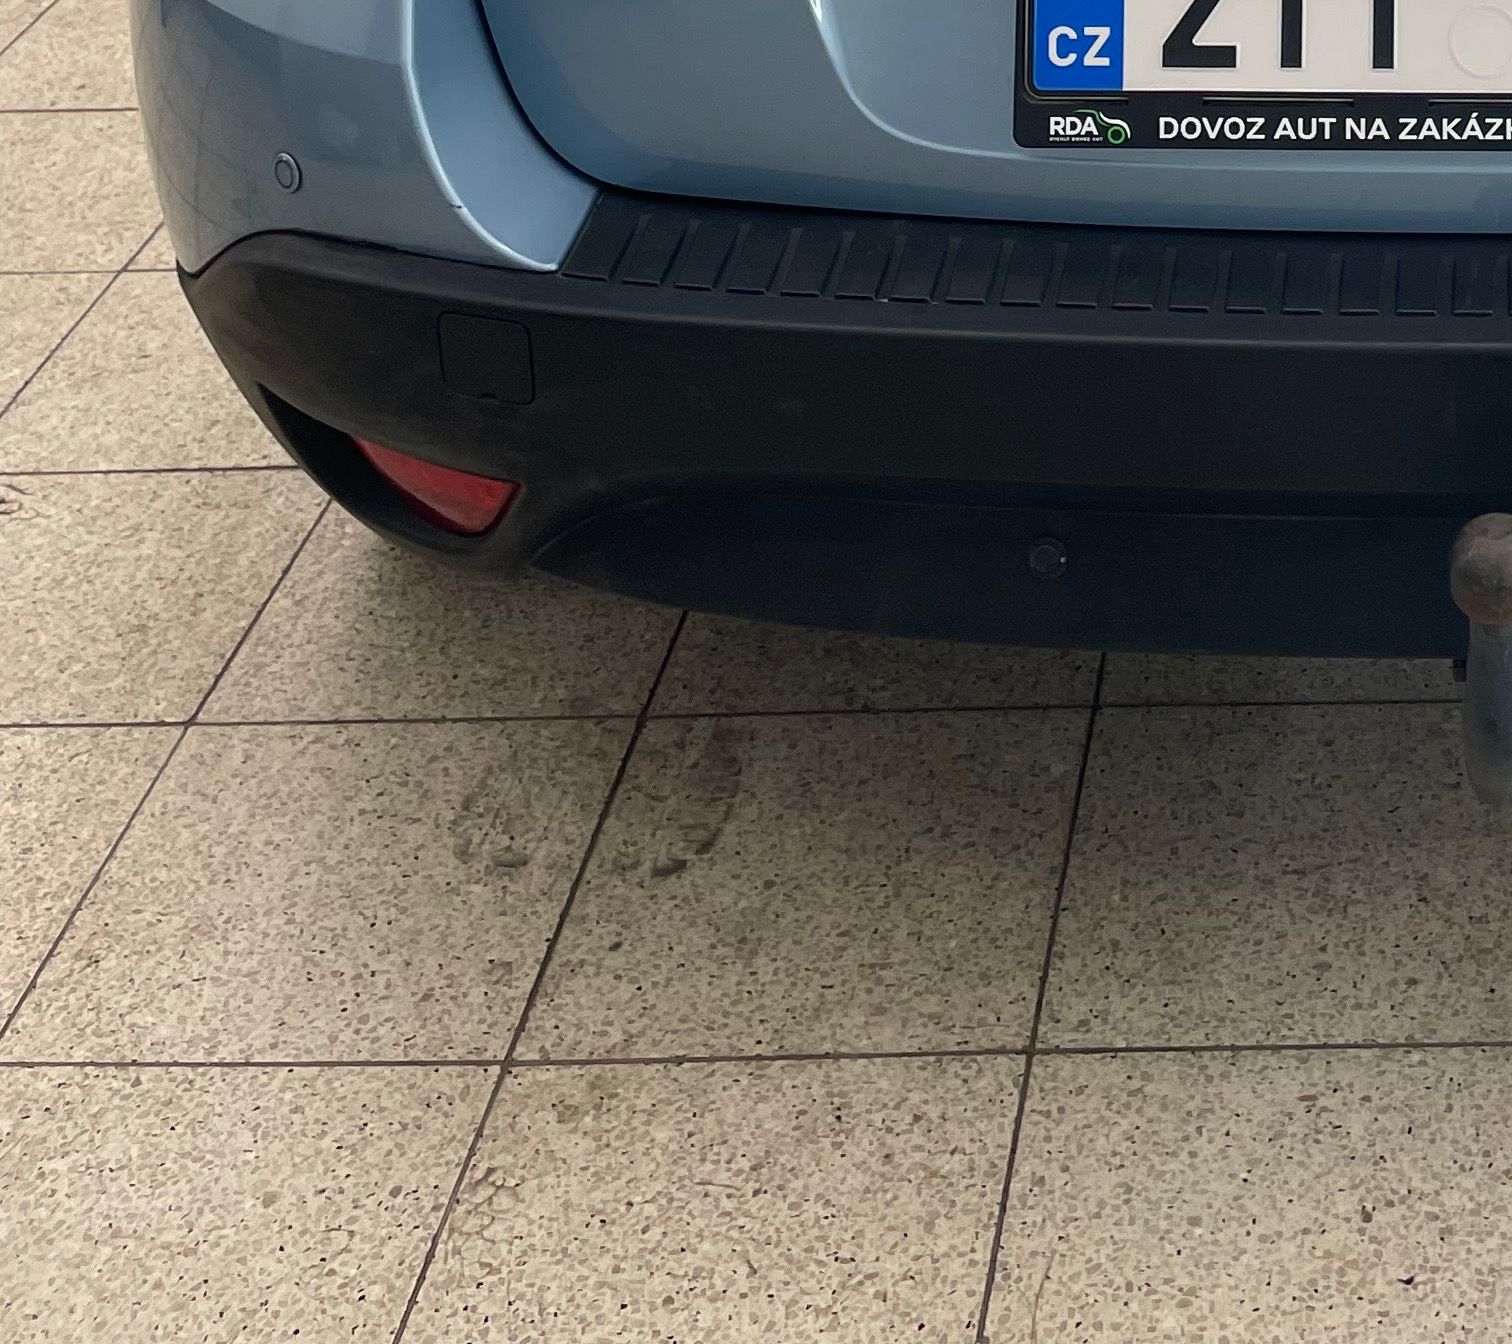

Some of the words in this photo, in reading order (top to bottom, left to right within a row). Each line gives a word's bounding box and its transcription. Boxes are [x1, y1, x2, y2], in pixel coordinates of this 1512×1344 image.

[1047, 26, 1111, 68] CZ
[1049, 116, 1099, 136] RDA
[1158, 116, 1266, 141] DOVOZ
[1273, 117, 1337, 141] AUT
[1344, 117, 1390, 141] NA
